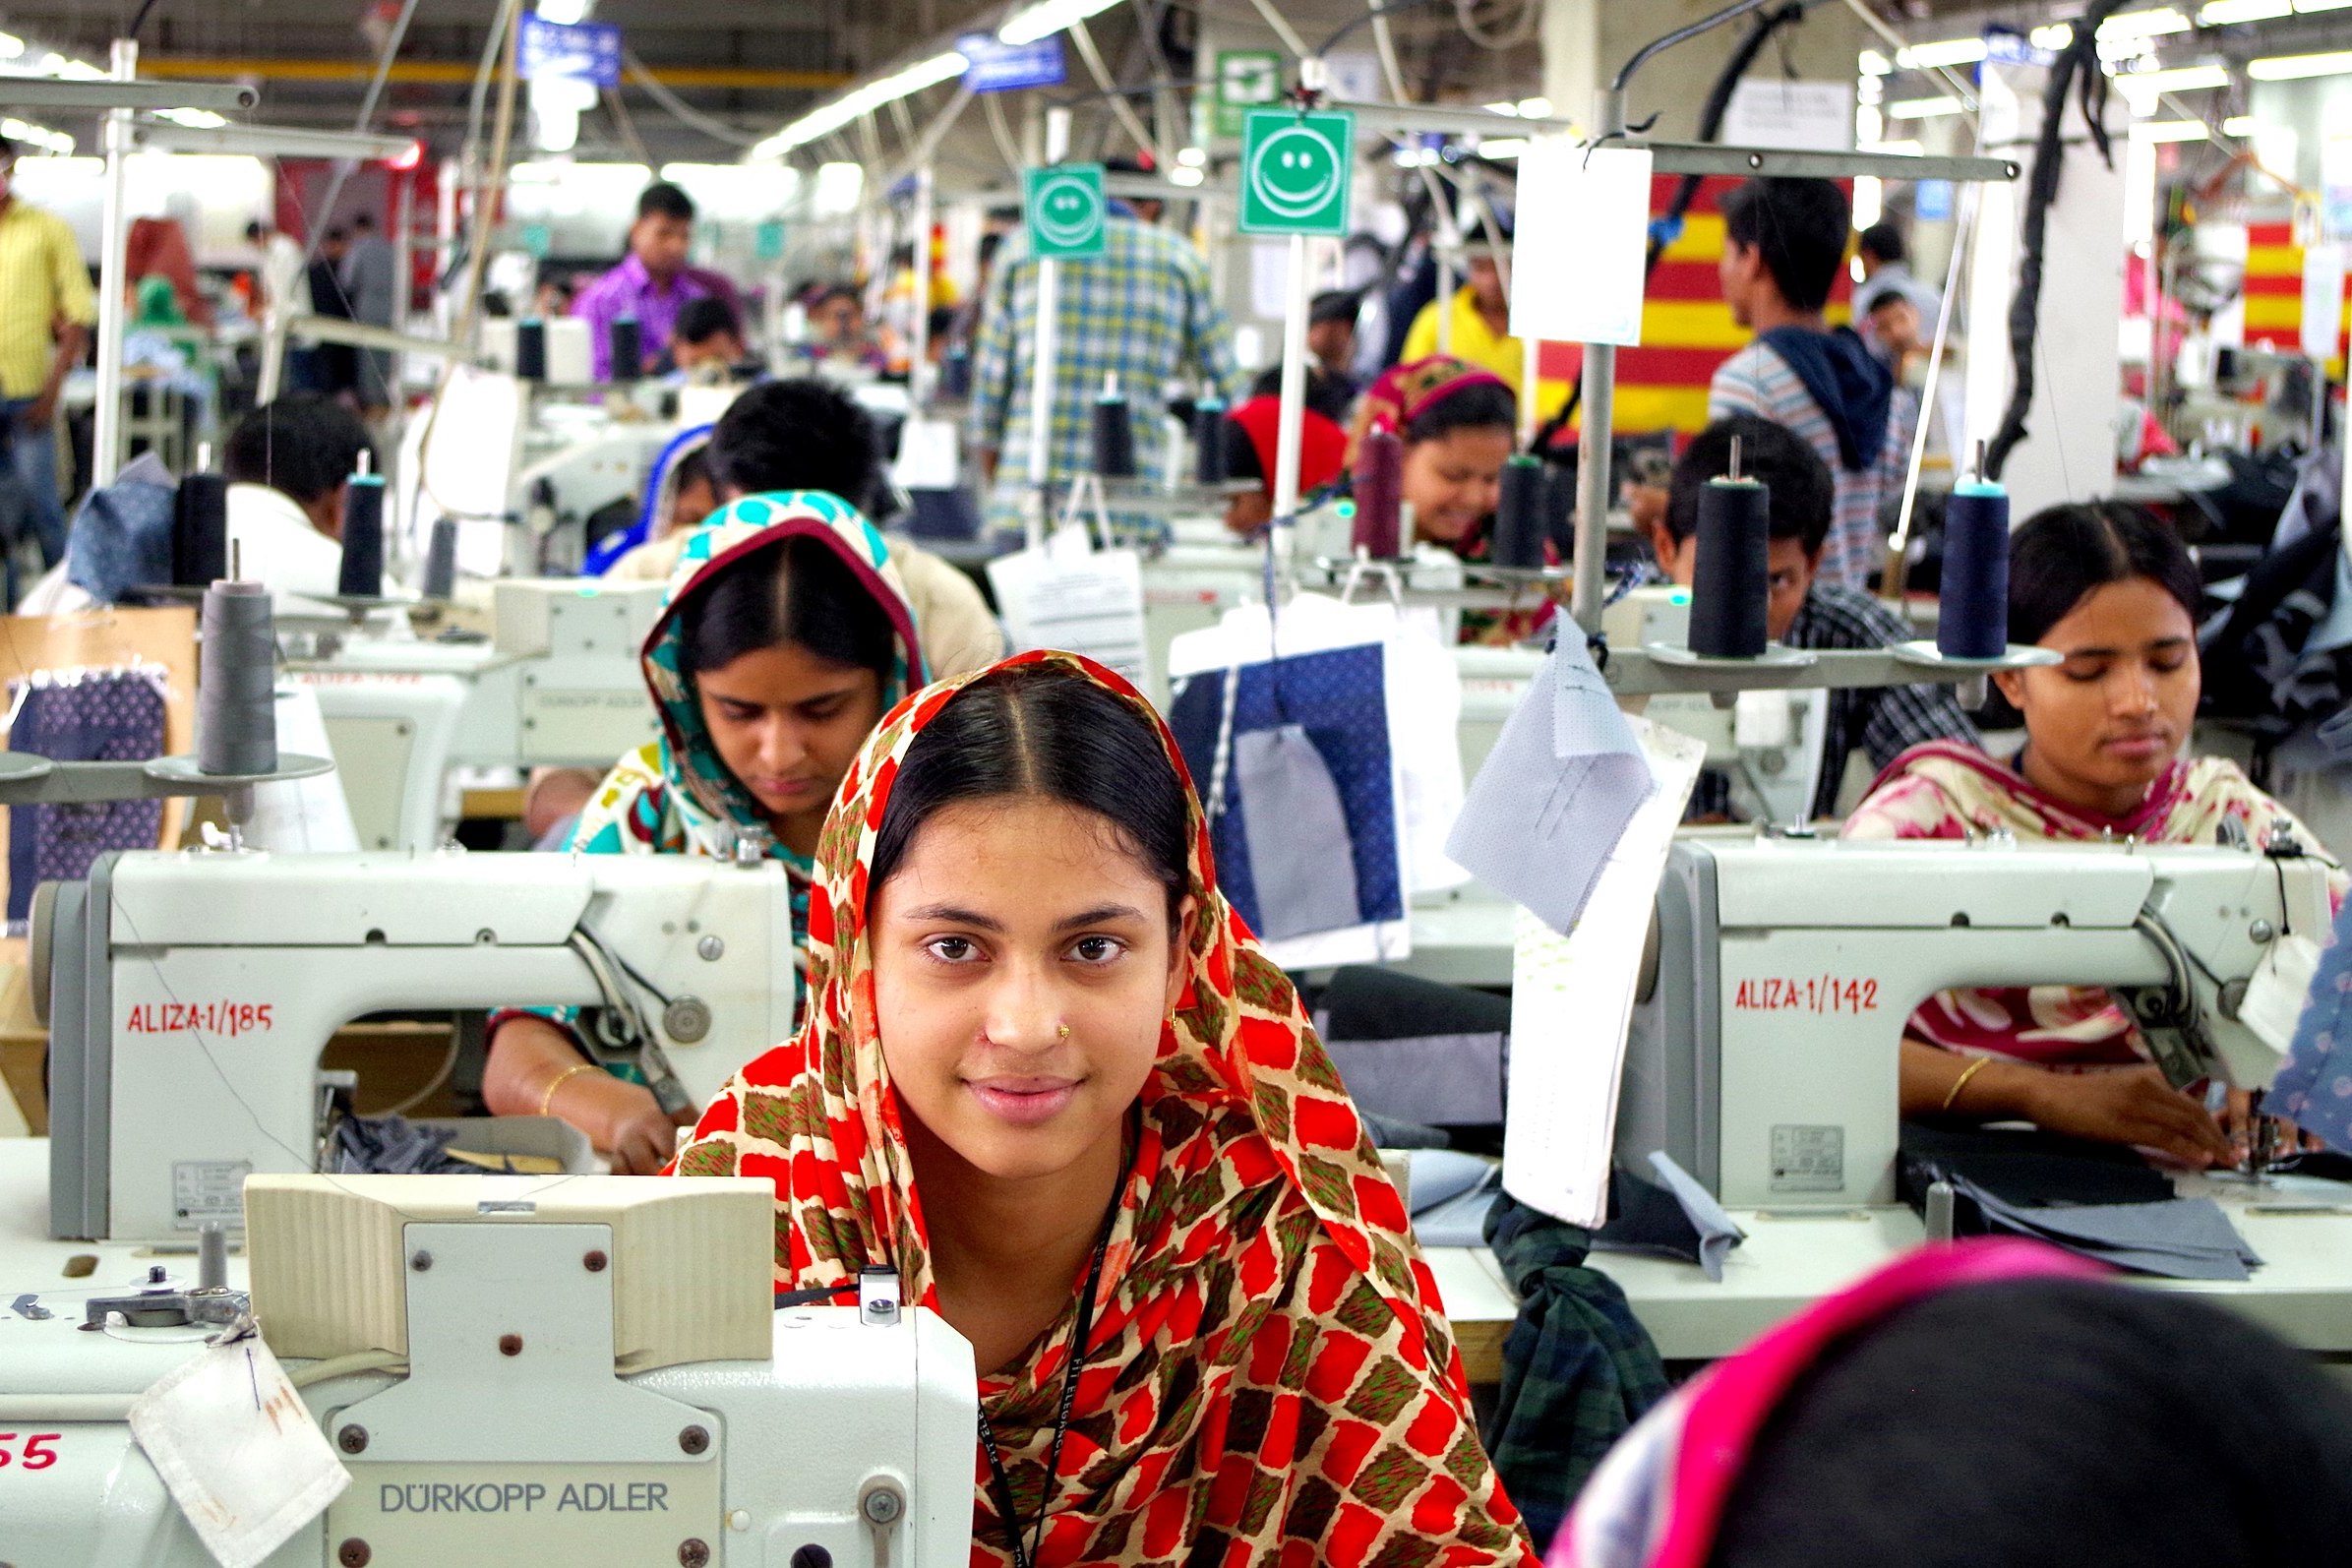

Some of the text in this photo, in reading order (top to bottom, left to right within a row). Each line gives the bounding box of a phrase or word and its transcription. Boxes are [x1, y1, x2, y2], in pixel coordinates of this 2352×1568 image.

[1735, 973, 1878, 1015] ALIZA-1/142
[128, 998, 273, 1037] ALIZA-1/185
[1054, 1357, 1082, 1457] FIT ELEGANCE
[381, 1482, 669, 1513] DÜRKOPP ADLER
